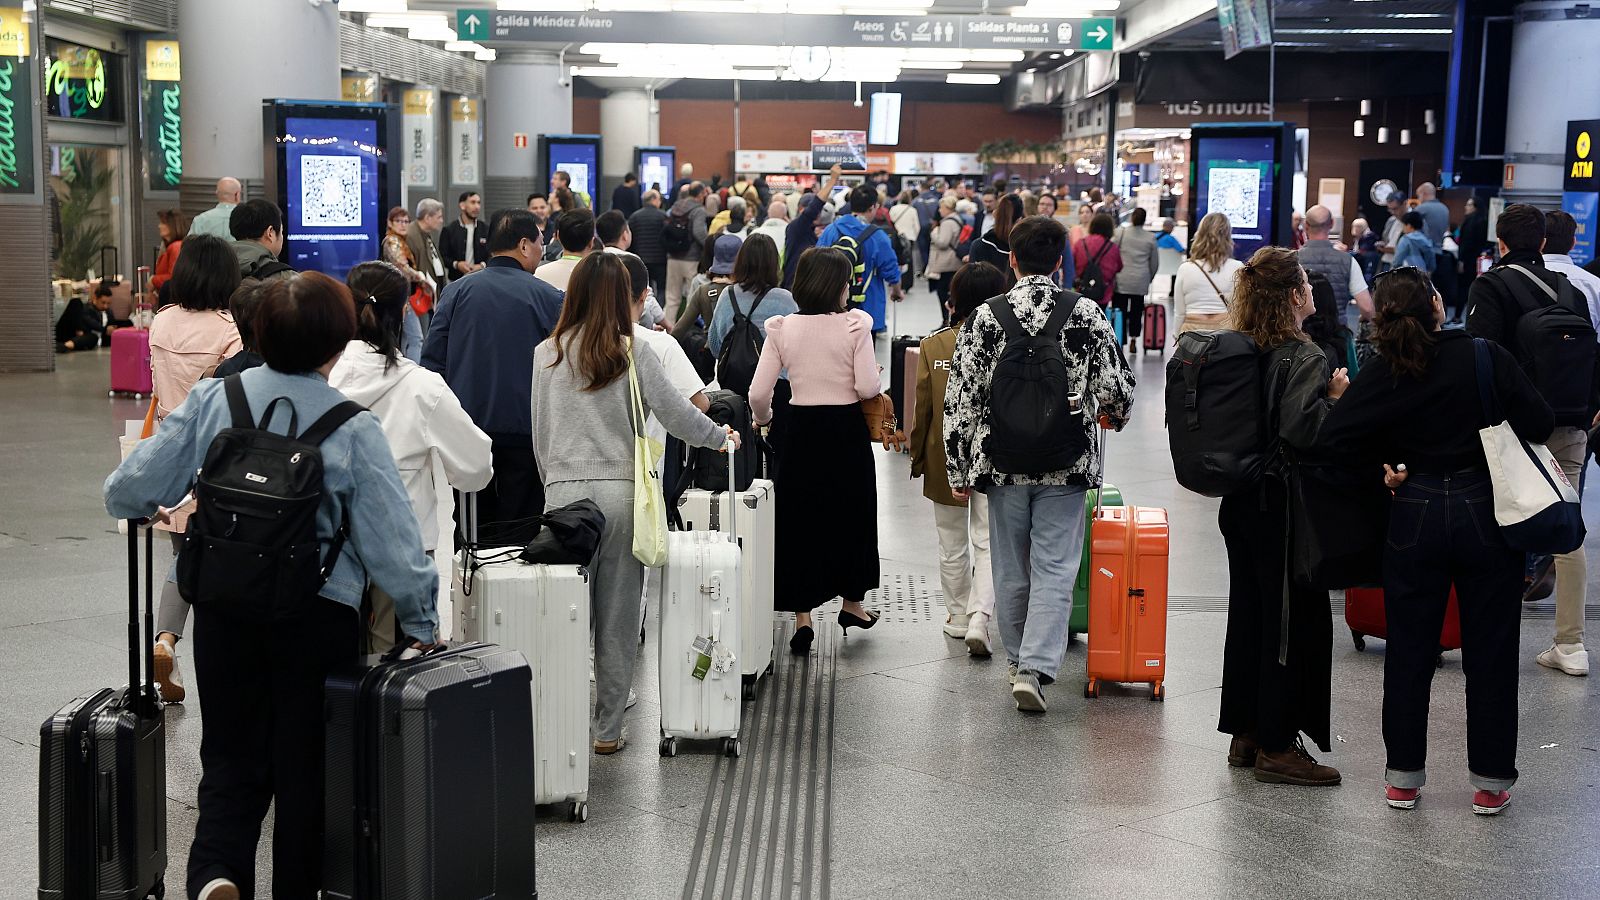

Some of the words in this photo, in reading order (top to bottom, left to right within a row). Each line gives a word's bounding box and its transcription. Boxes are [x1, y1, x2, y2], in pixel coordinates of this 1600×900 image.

[495, 14, 529, 27] Salida
[533, 14, 576, 28] Méndez
[578, 15, 613, 28] Álvaro
[853, 20, 885, 32] Aseos
[968, 21, 1004, 33] Salidas
[1007, 22, 1040, 34] Planta
[1042, 23, 1049, 33] 1
[158, 83, 182, 186] natura
[1571, 161, 1593, 178] ATM
